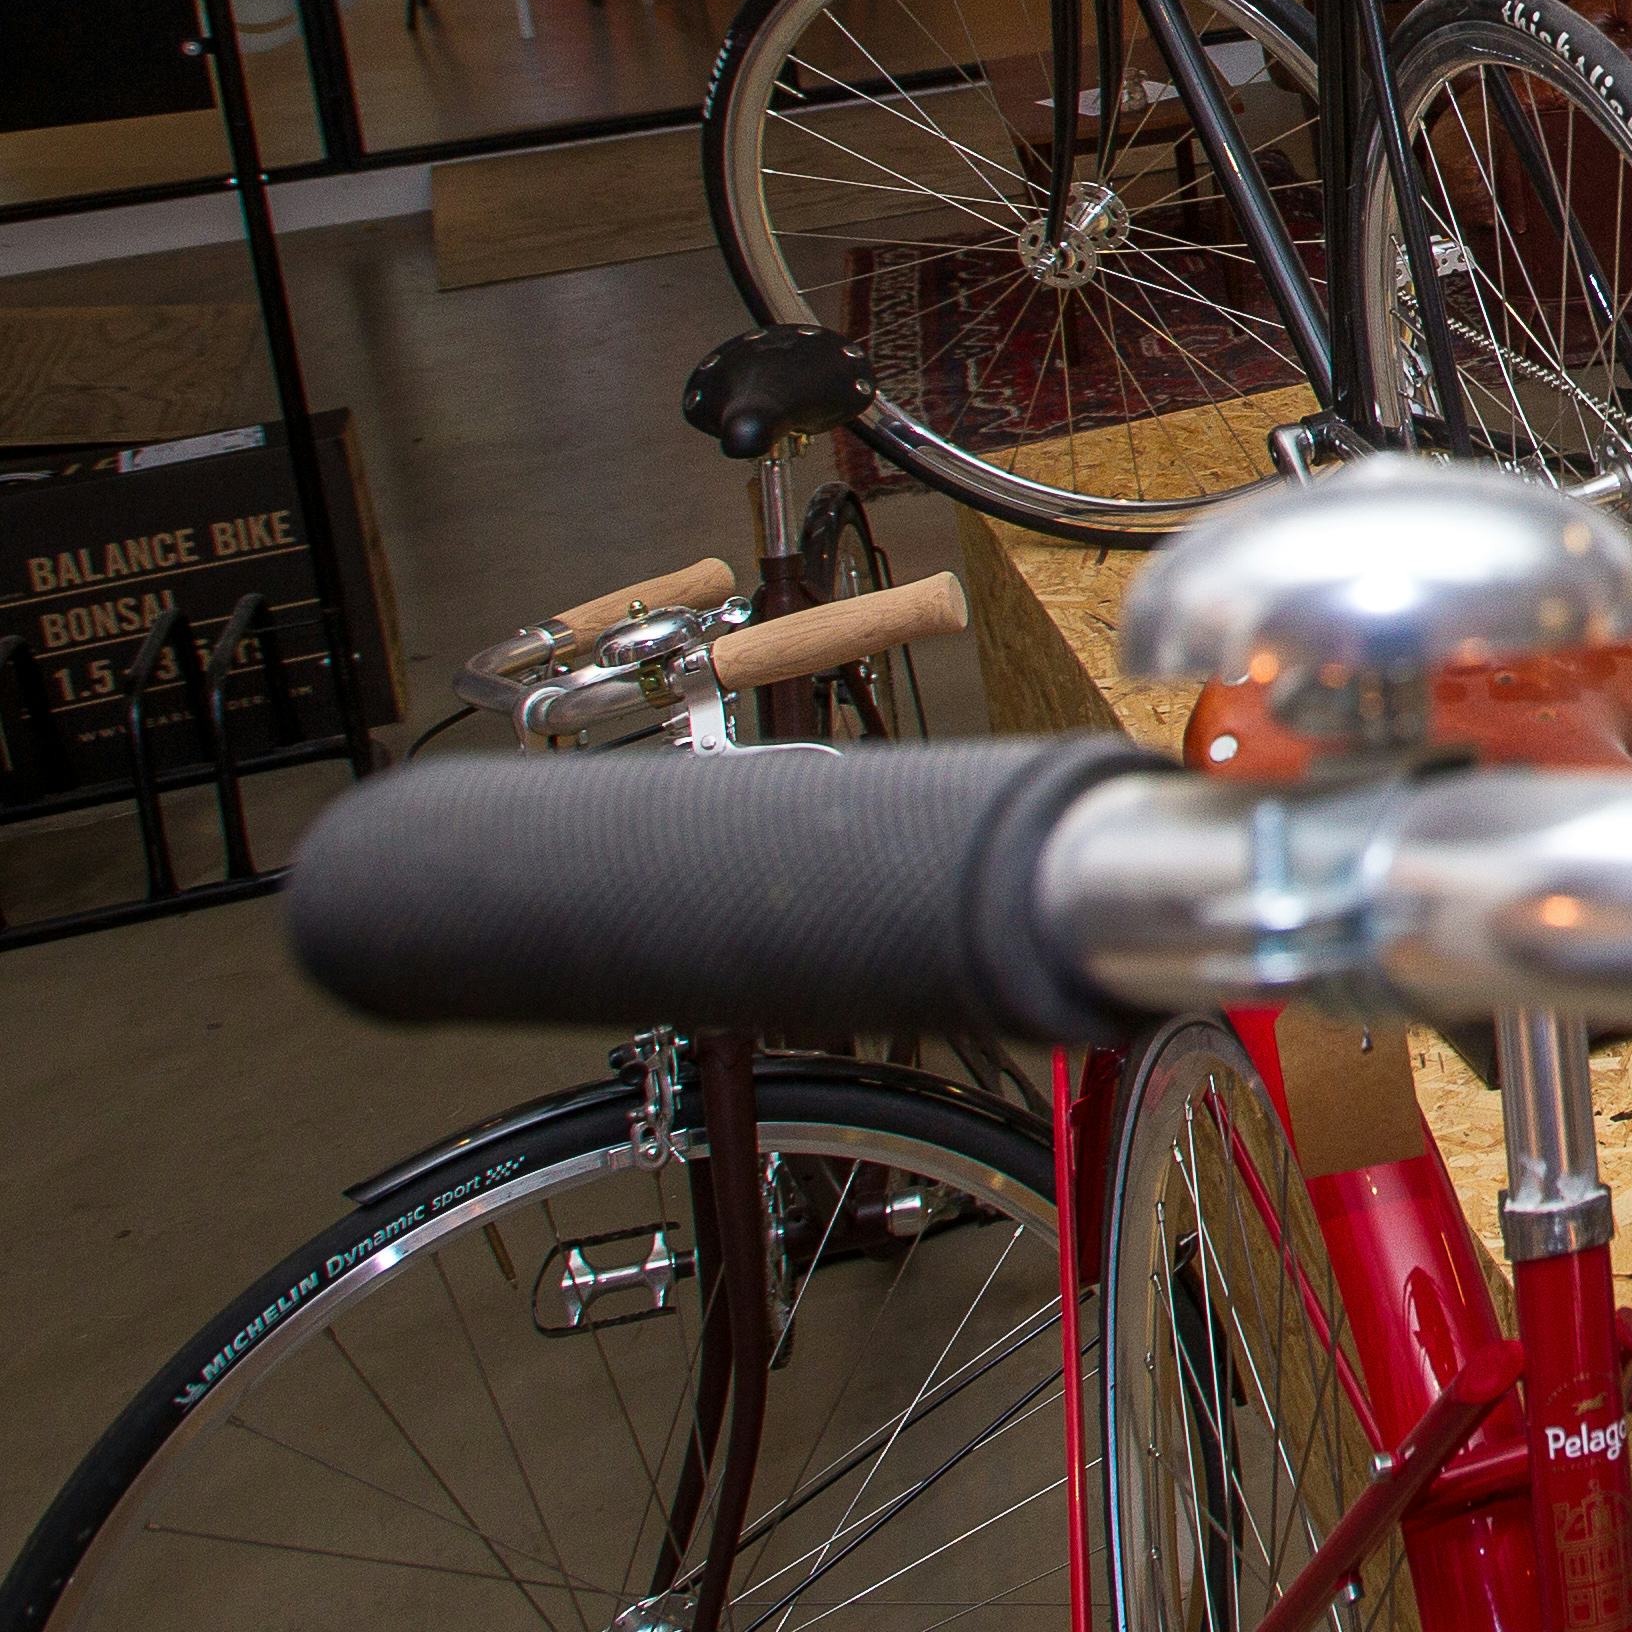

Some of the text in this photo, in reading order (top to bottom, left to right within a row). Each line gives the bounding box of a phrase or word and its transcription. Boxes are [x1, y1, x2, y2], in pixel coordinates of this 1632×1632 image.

[26, 508, 297, 594] BALANCE BIKE
[39, 589, 177, 649] BONSAI
[201, 1175, 481, 1382] MICHELIN Dynamic sport
[1544, 1421, 1627, 1461] Pelago
